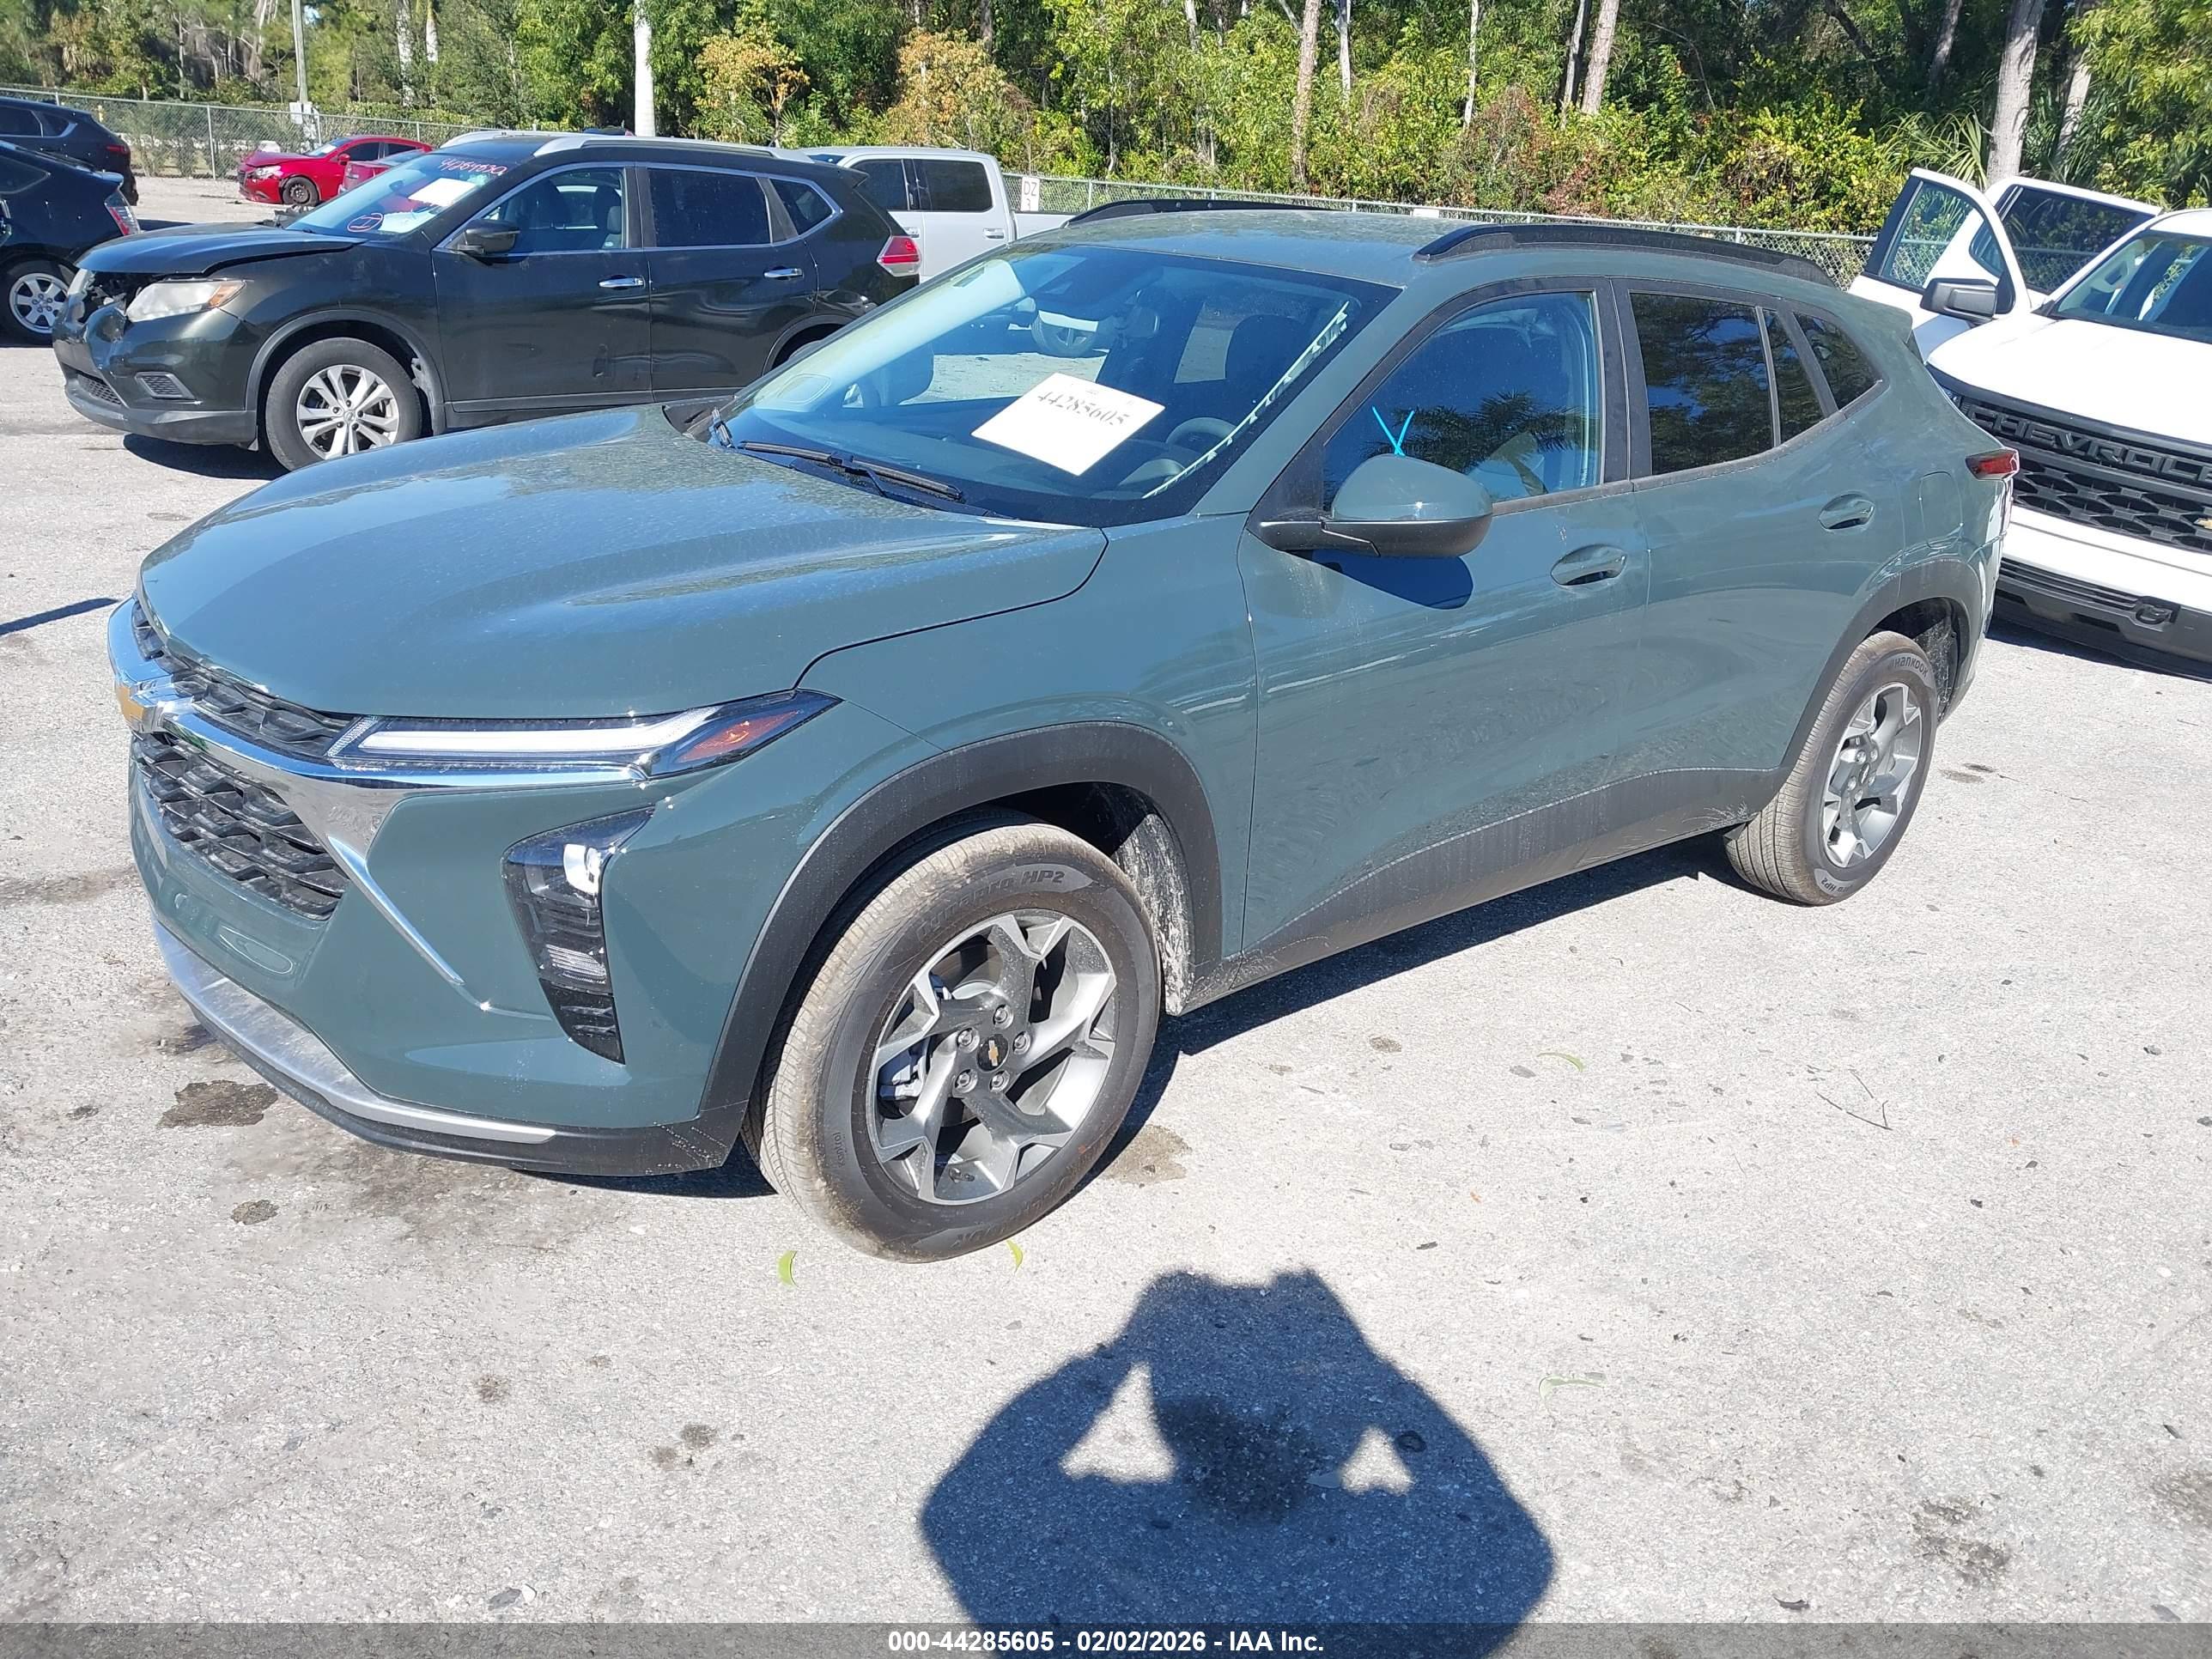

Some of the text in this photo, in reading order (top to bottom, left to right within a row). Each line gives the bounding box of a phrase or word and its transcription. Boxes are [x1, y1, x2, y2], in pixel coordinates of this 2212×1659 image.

[1024, 180, 1037, 197] DZ
[1036, 391, 1130, 426] 44285605
[1020, 869, 1066, 885] HP2
